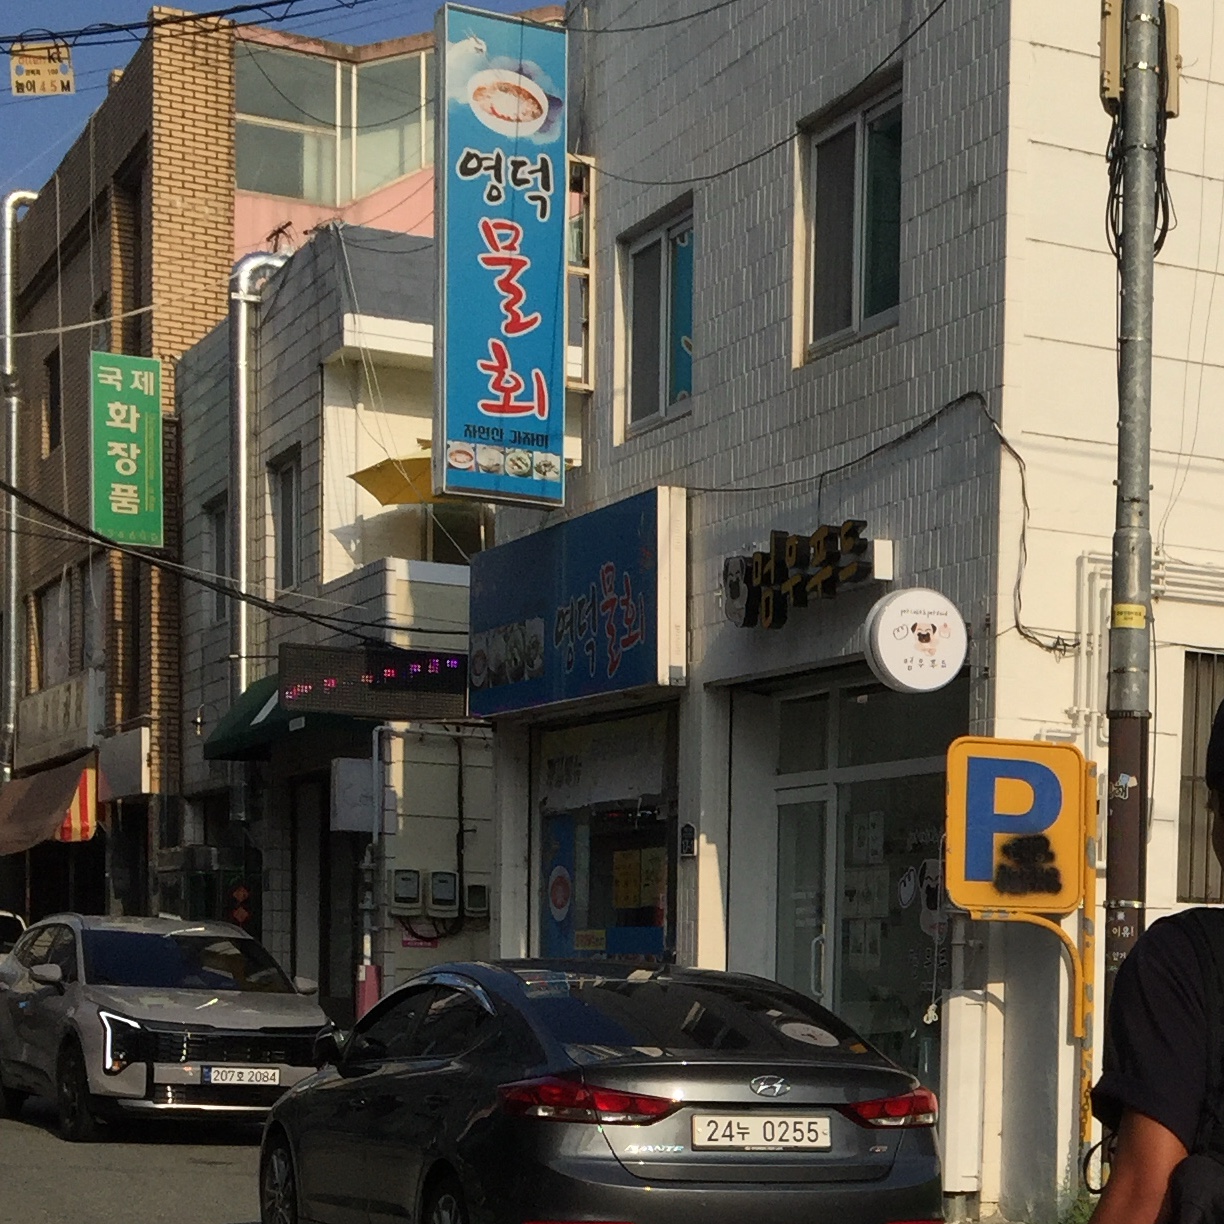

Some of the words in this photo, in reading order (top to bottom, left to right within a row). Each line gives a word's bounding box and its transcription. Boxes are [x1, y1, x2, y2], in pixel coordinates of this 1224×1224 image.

[15, 79, 36, 94] 높이
[458, 150, 551, 220] 영덕
[479, 218, 548, 419] 물회
[97, 365, 155, 396] 국제
[463, 423, 504, 442] 자연산
[509, 429, 550, 449] 가자미
[105, 401, 141, 515] 화장품
[964, 756, 1063, 883] P
[212, 1069, 245, 1082] 207호
[247, 1070, 277, 1083] 2084
[706, 1119, 751, 1142] 24누
[762, 1120, 820, 1143] 0255
